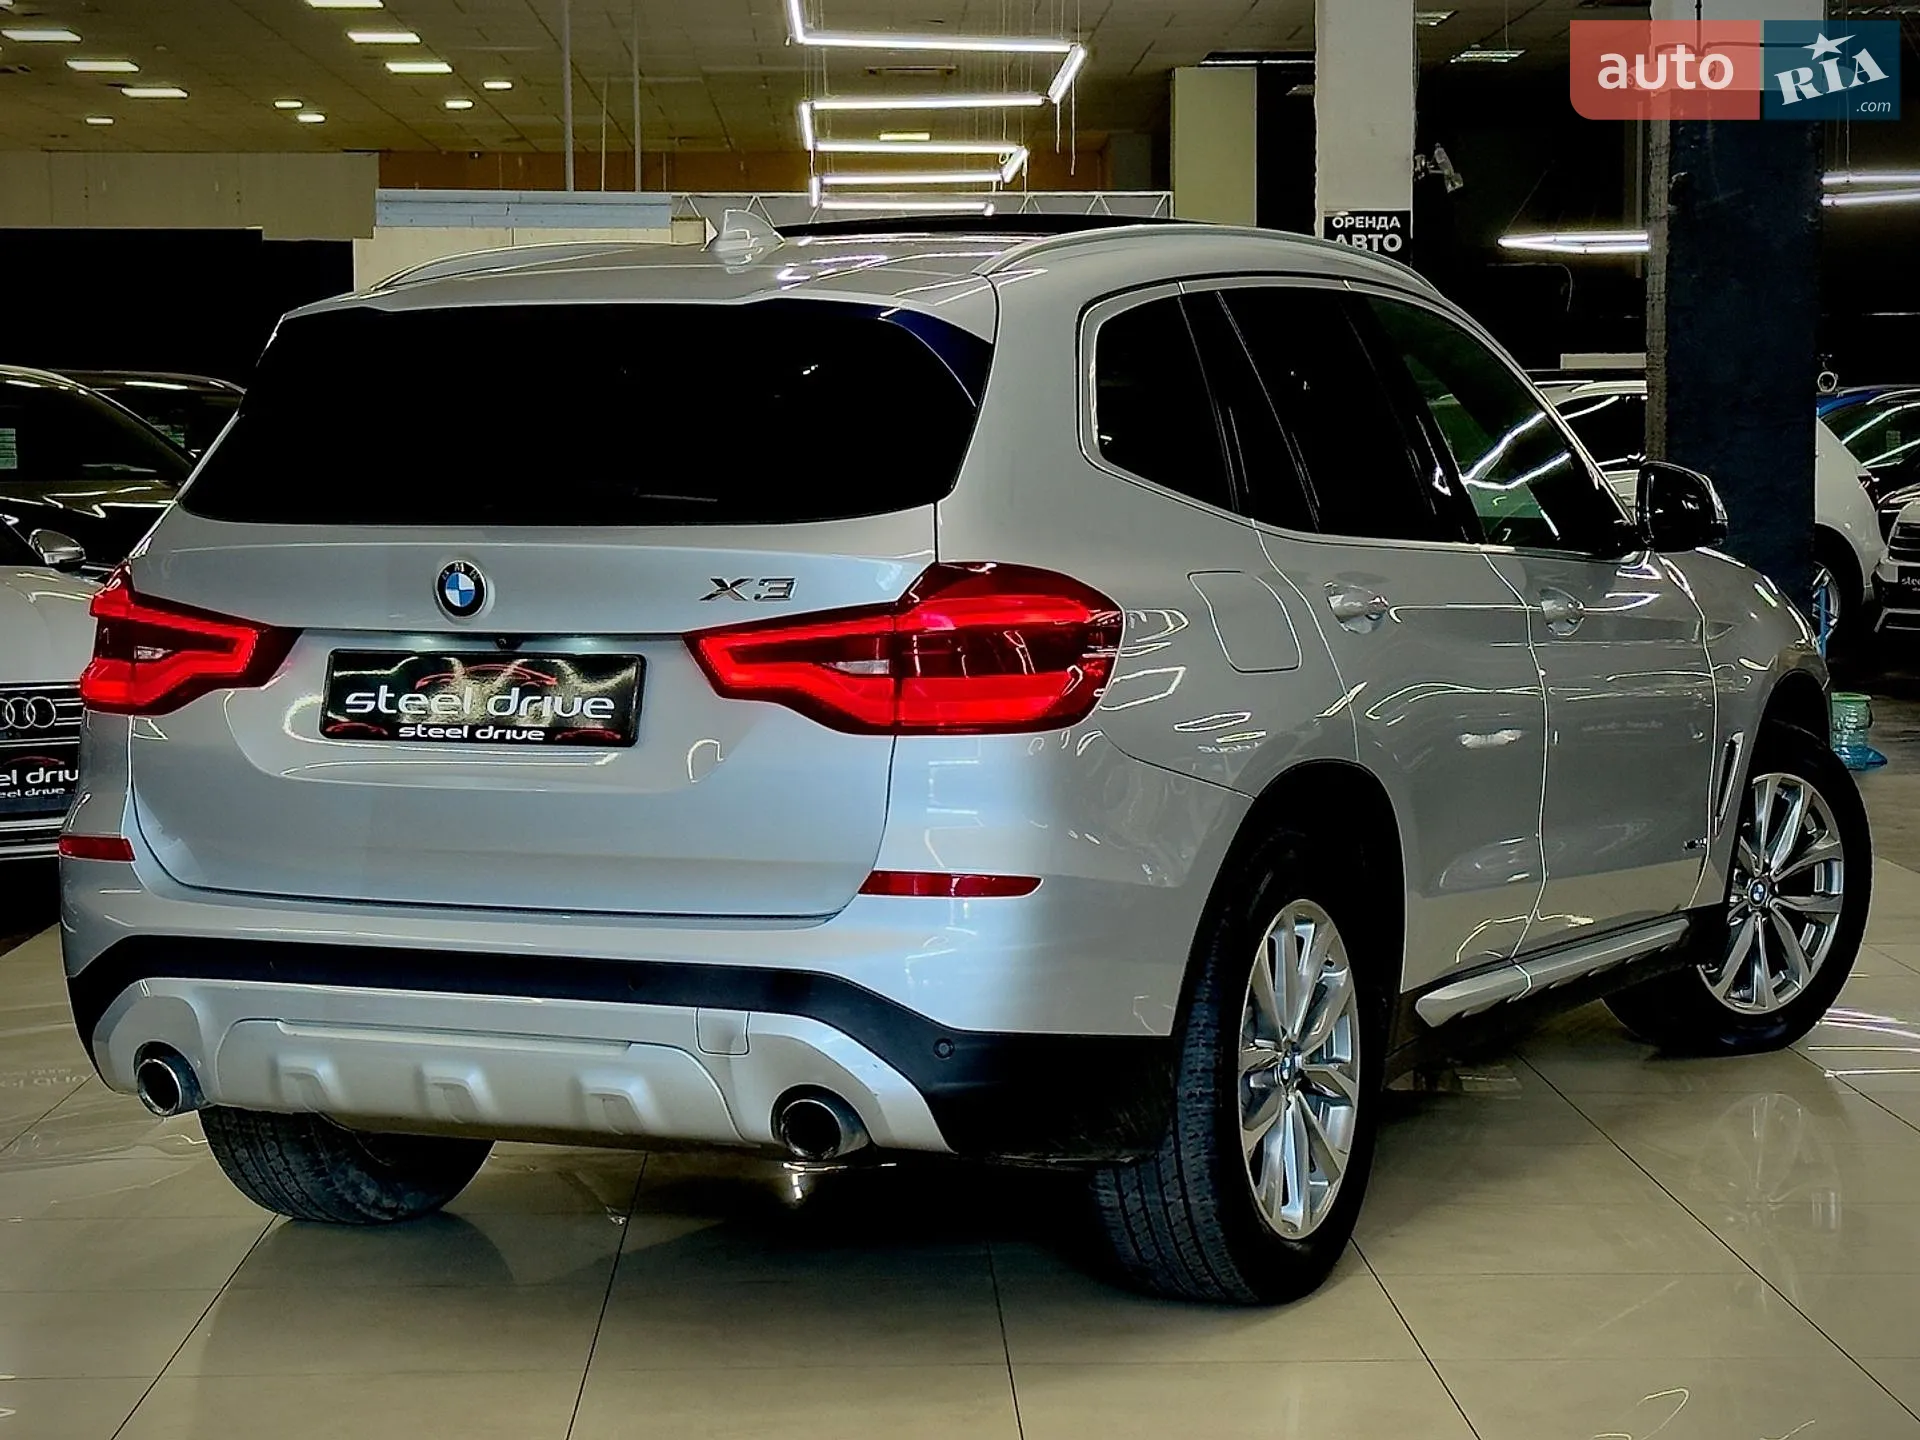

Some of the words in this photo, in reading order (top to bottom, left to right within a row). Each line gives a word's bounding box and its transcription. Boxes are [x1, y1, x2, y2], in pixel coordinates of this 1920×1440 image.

[1332, 216, 1401, 230] ОРЕНДА
[1335, 234, 1403, 252] АВТО
[699, 577, 797, 603] X3
[345, 684, 473, 715] steel
[487, 687, 615, 719] drive
[399, 724, 469, 739] steel
[475, 725, 546, 741] drive
[25, 788, 65, 797] drive
